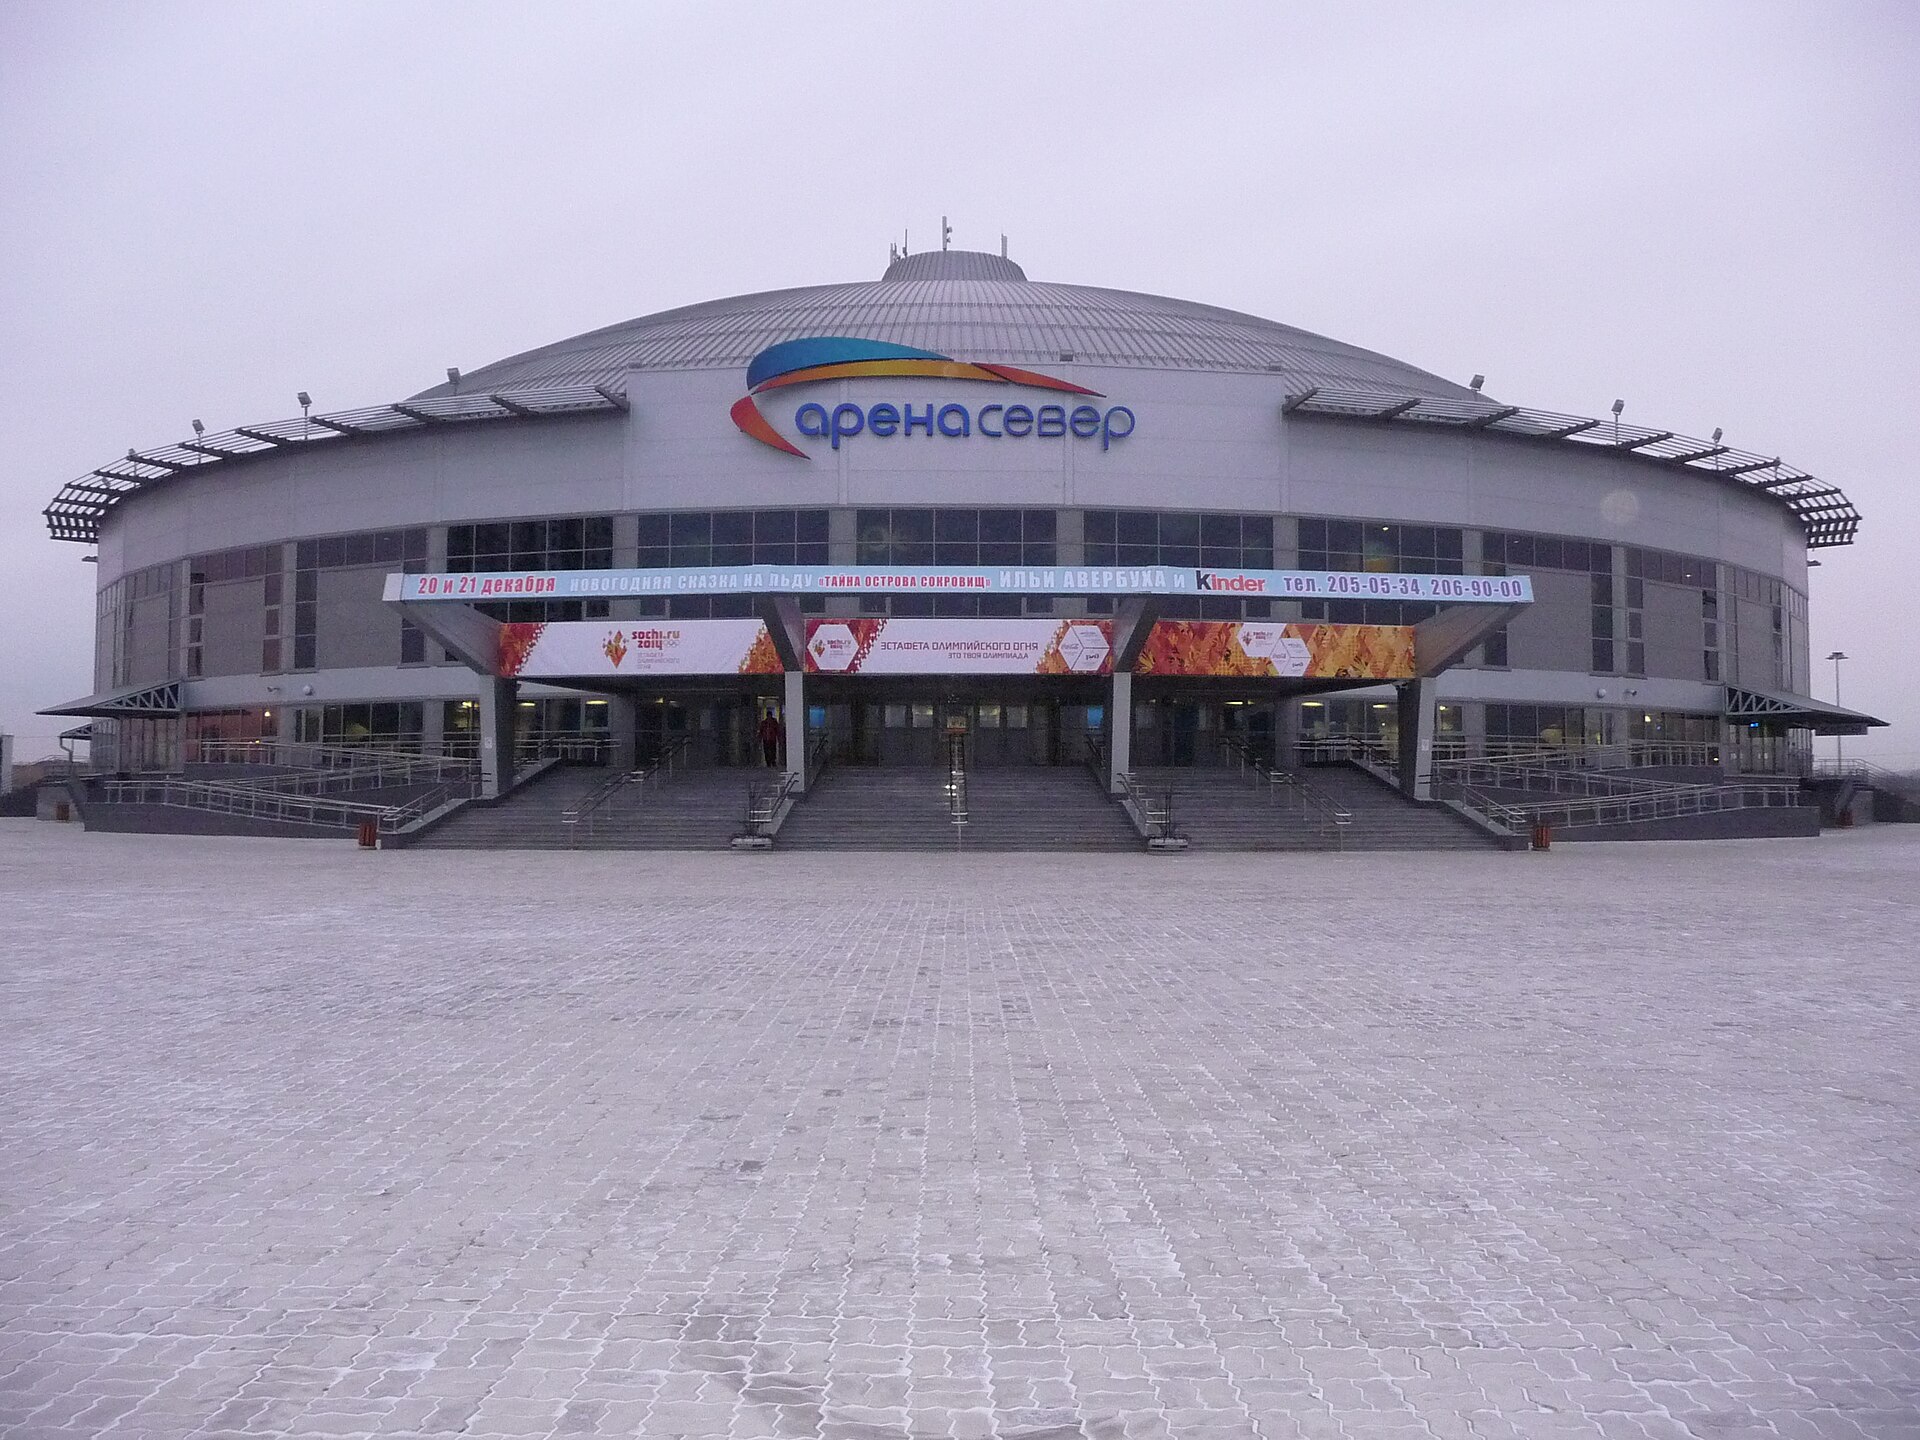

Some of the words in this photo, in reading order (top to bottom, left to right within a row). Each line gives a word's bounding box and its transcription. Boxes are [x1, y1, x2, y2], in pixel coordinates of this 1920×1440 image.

[795, 403, 970, 449] арена
[978, 404, 1136, 450] север
[418, 577, 438, 594] 20
[442, 578, 453, 594] и
[458, 576, 477, 593] 21
[481, 575, 556, 595] декабря
[678, 574, 738, 590] СКАЗКА
[743, 573, 763, 588] НА
[768, 573, 813, 589] ЛЬДУ
[818, 573, 861, 588] «ТАЙНА
[865, 576, 917, 588] ОСТРОВА
[920, 576, 991, 589] СОКРОВИЩ»
[999, 571, 1055, 588] ИЛЬИ
[1063, 570, 1167, 588] АВЕРБУХА
[1195, 570, 1266, 592] Kinder
[1283, 577, 1322, 592] тел.
[1327, 576, 1426, 597] 205-05-34,
[1430, 579, 1523, 598] 206-90-00
[631, 629, 680, 640] sochi.ru
[637, 640, 663, 650] 2014
[881, 641, 930, 650] ЭСТАФЕТА
[932, 641, 1011, 650] ОЛИМПИЙСКОГО
[1013, 641, 1039, 650] ОГНЯ
[982, 652, 1029, 660] ОЛИМПИАДА
